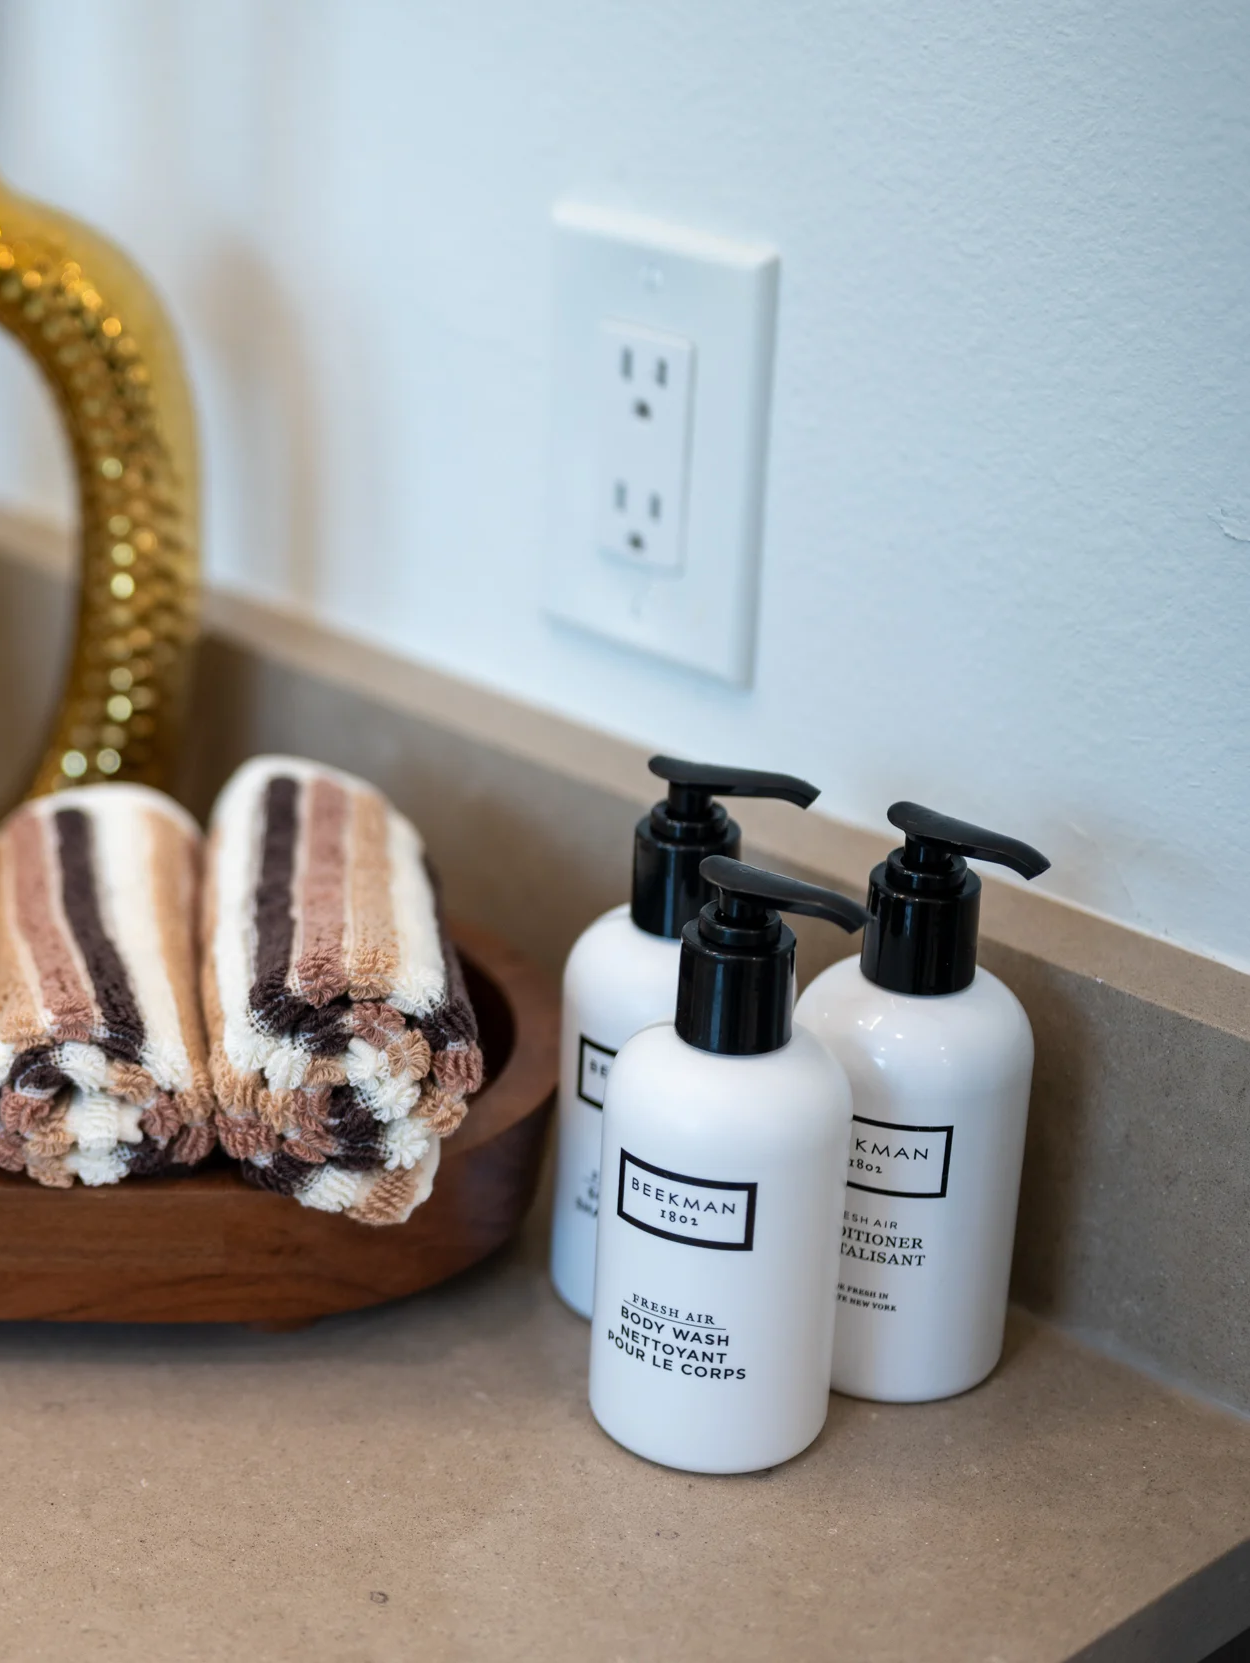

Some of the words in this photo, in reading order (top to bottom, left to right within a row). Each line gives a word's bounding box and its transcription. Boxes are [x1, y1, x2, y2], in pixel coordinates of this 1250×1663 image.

[855, 1137, 929, 1160] KMAN
[849, 1158, 882, 1174] 1802
[631, 1176, 736, 1215] BEEKMAN
[660, 1209, 699, 1226] 1802
[843, 1210, 869, 1225] ESH
[873, 1219, 898, 1230] AIR
[840, 1242, 926, 1267] TALISANT
[847, 1285, 877, 1299] FRESH
[878, 1292, 889, 1300] IN
[632, 1292, 680, 1319] FRESH
[685, 1312, 716, 1326] AIR
[849, 1298, 870, 1309] NEW
[871, 1301, 897, 1312] YORK
[620, 1305, 665, 1334] BODY
[672, 1327, 730, 1347] WASH
[607, 1328, 646, 1362] POUR
[652, 1354, 674, 1372] LE
[680, 1363, 747, 1380] CORPS
[620, 1323, 728, 1365] NETTOYANT
